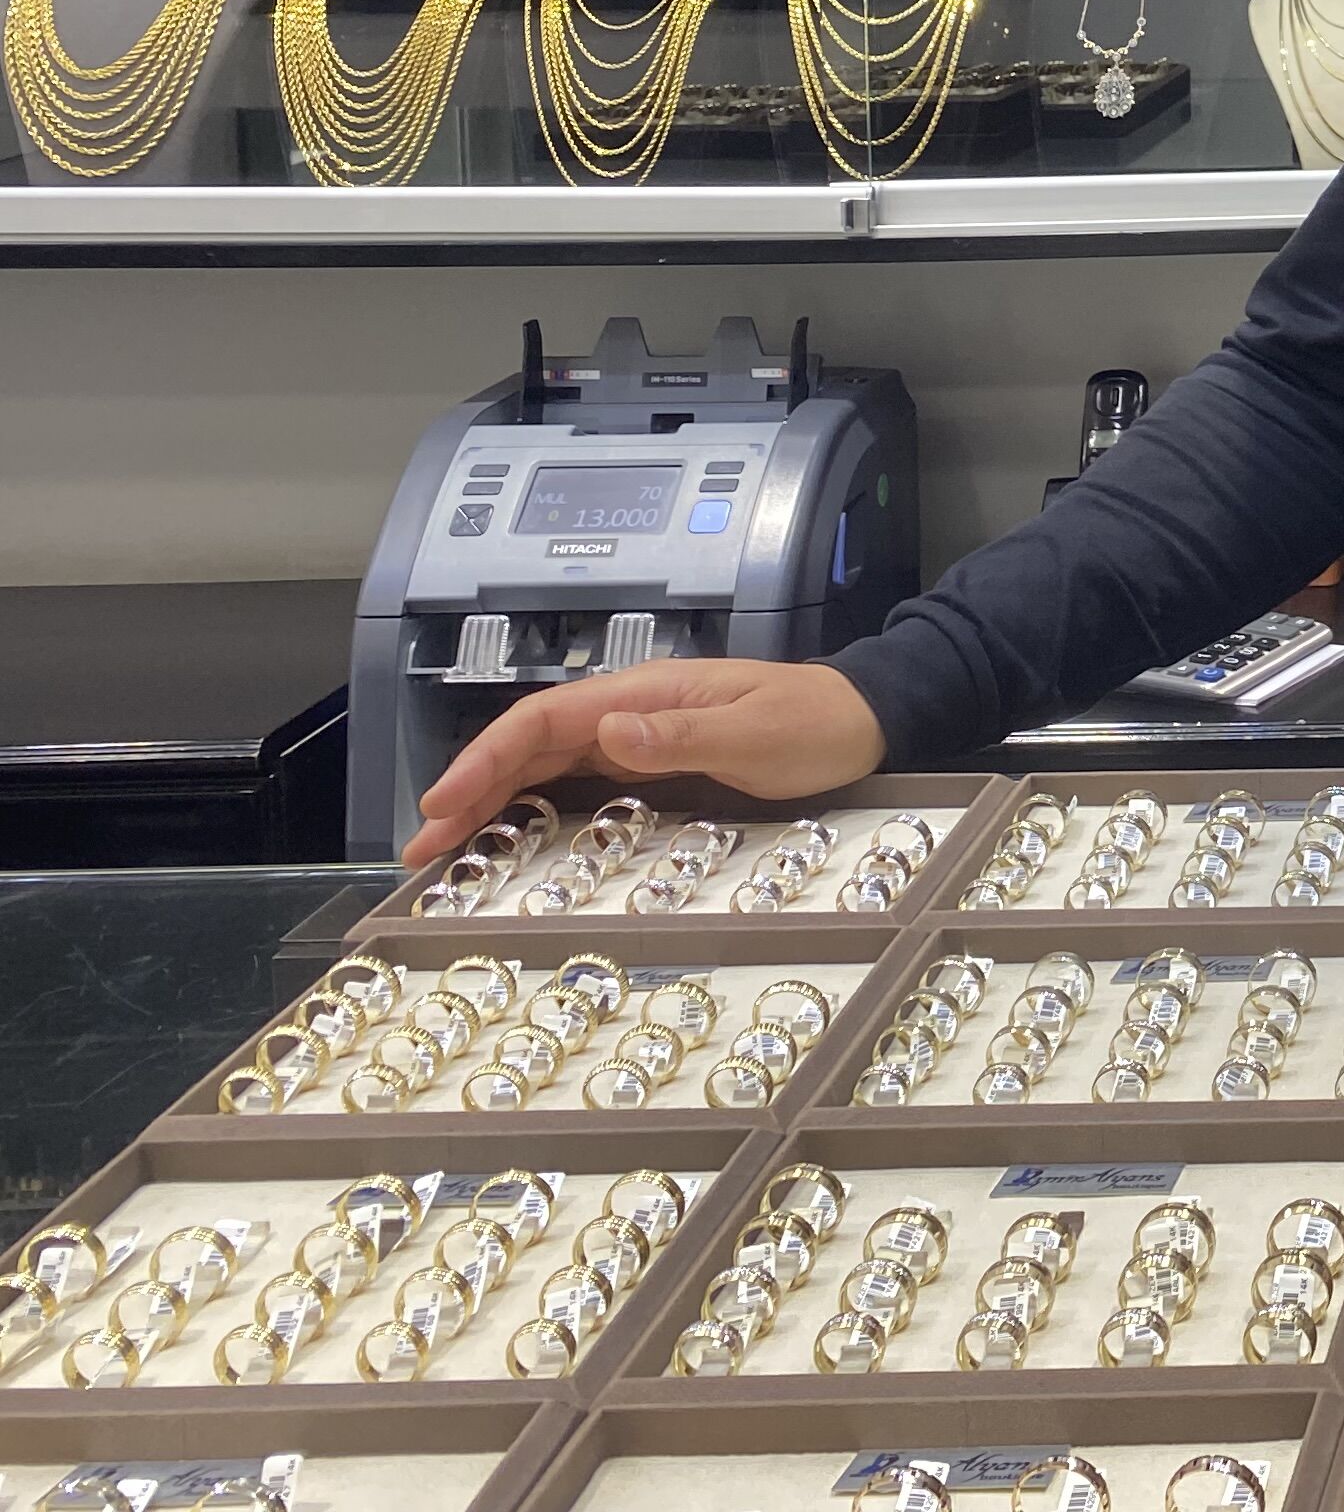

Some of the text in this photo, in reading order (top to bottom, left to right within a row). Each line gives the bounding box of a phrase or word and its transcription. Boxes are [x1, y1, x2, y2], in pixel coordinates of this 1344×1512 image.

[638, 486, 662, 501] 70
[571, 508, 659, 529] 13,000
[552, 543, 612, 554] HITACHI
